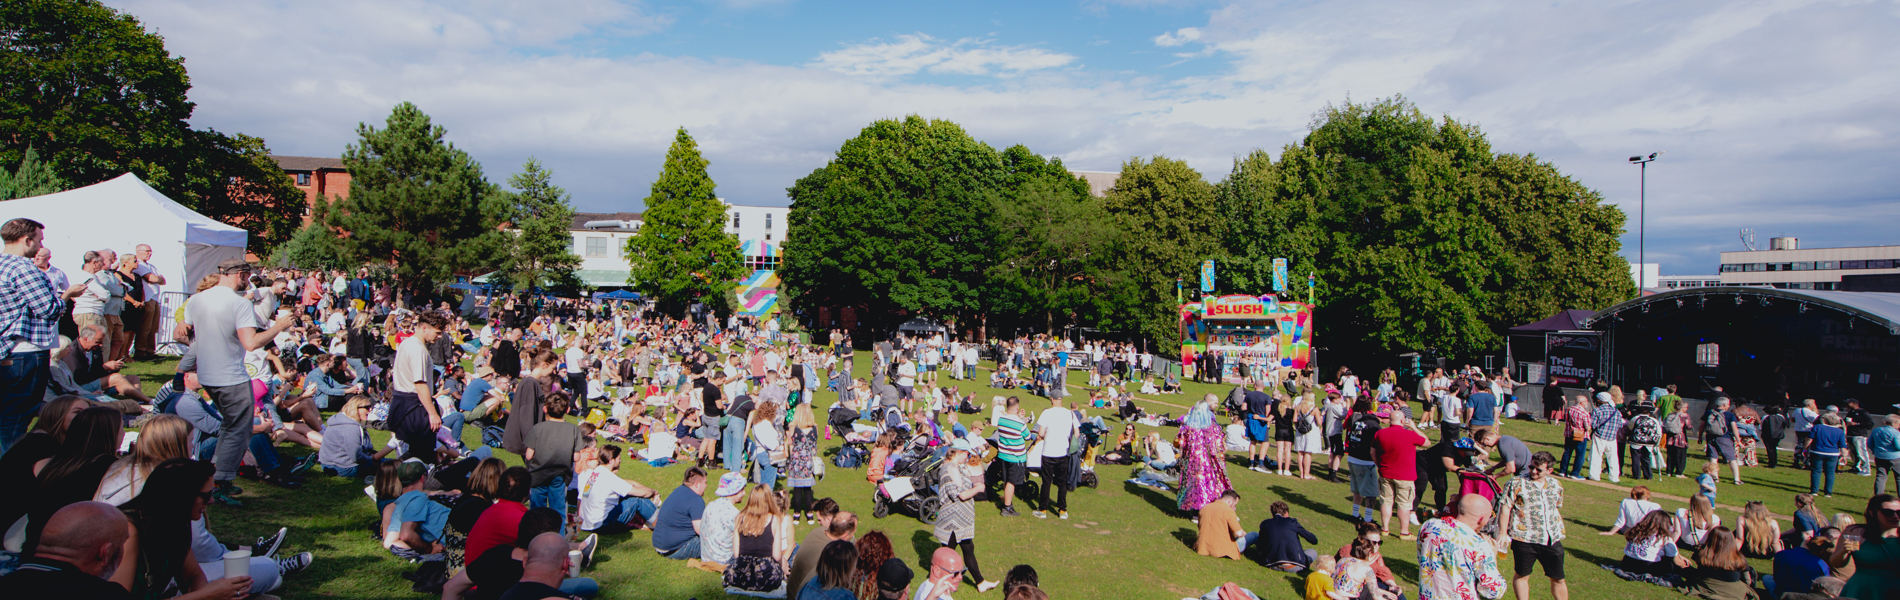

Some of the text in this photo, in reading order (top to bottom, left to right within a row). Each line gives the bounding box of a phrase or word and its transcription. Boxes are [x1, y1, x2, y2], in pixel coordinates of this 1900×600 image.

[1215, 304, 1263, 314] SLUSH
[1821, 334, 1900, 352] FRING
[1550, 355, 1573, 366] THE
[1550, 365, 1594, 378] FRINGE
